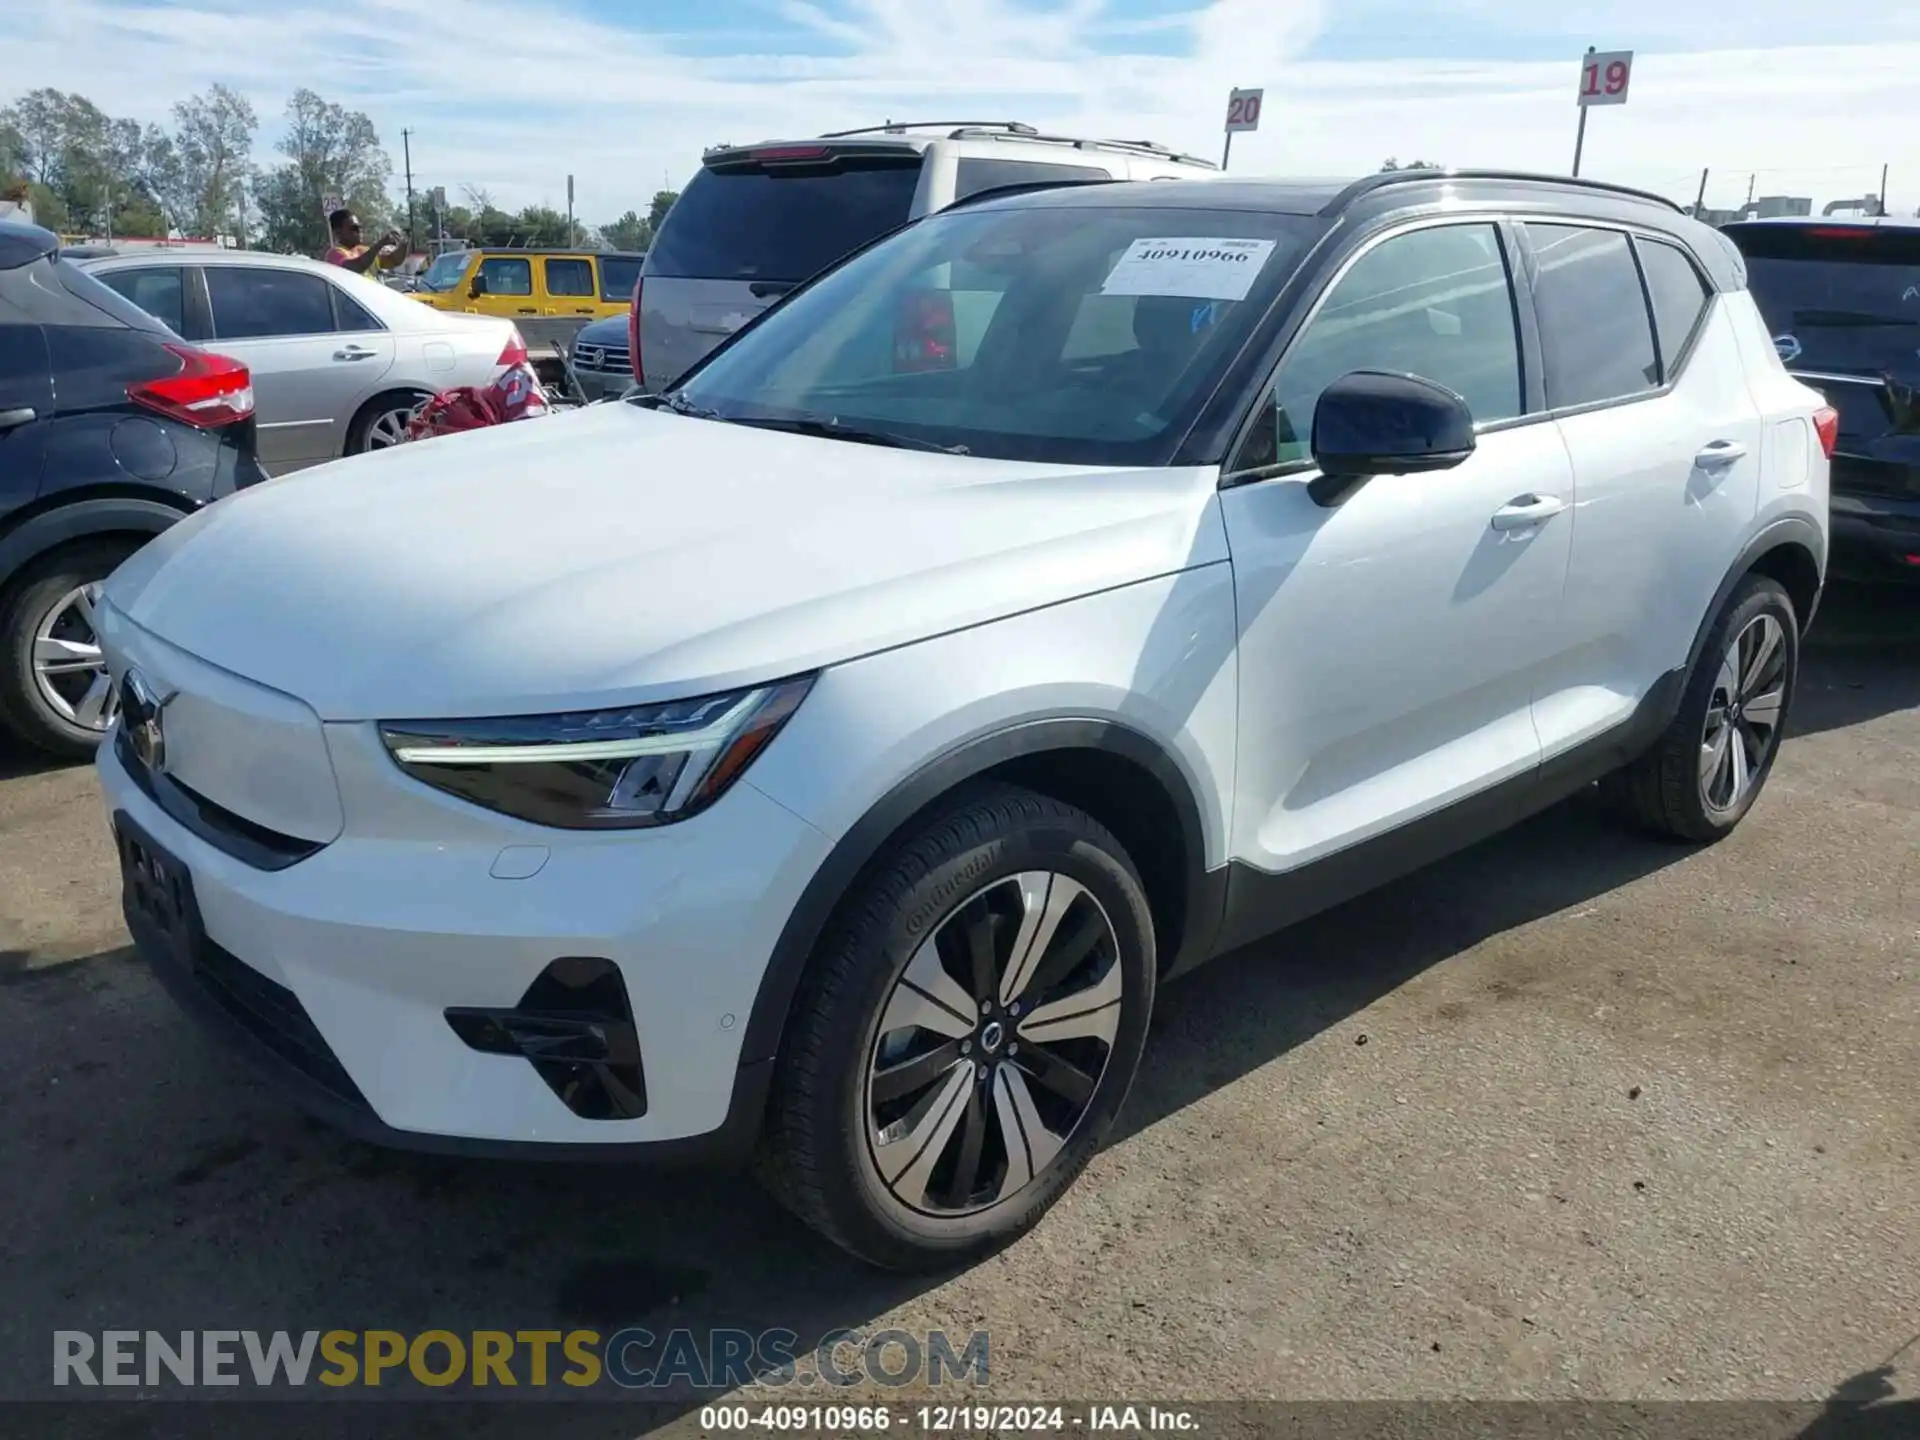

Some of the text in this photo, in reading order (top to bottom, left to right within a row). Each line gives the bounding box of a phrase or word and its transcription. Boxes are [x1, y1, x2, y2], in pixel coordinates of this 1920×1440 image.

[1582, 61, 1628, 96] 19
[1228, 96, 1260, 124] 20
[1137, 249, 1249, 263] 40910966
[905, 844, 995, 937] Continental
